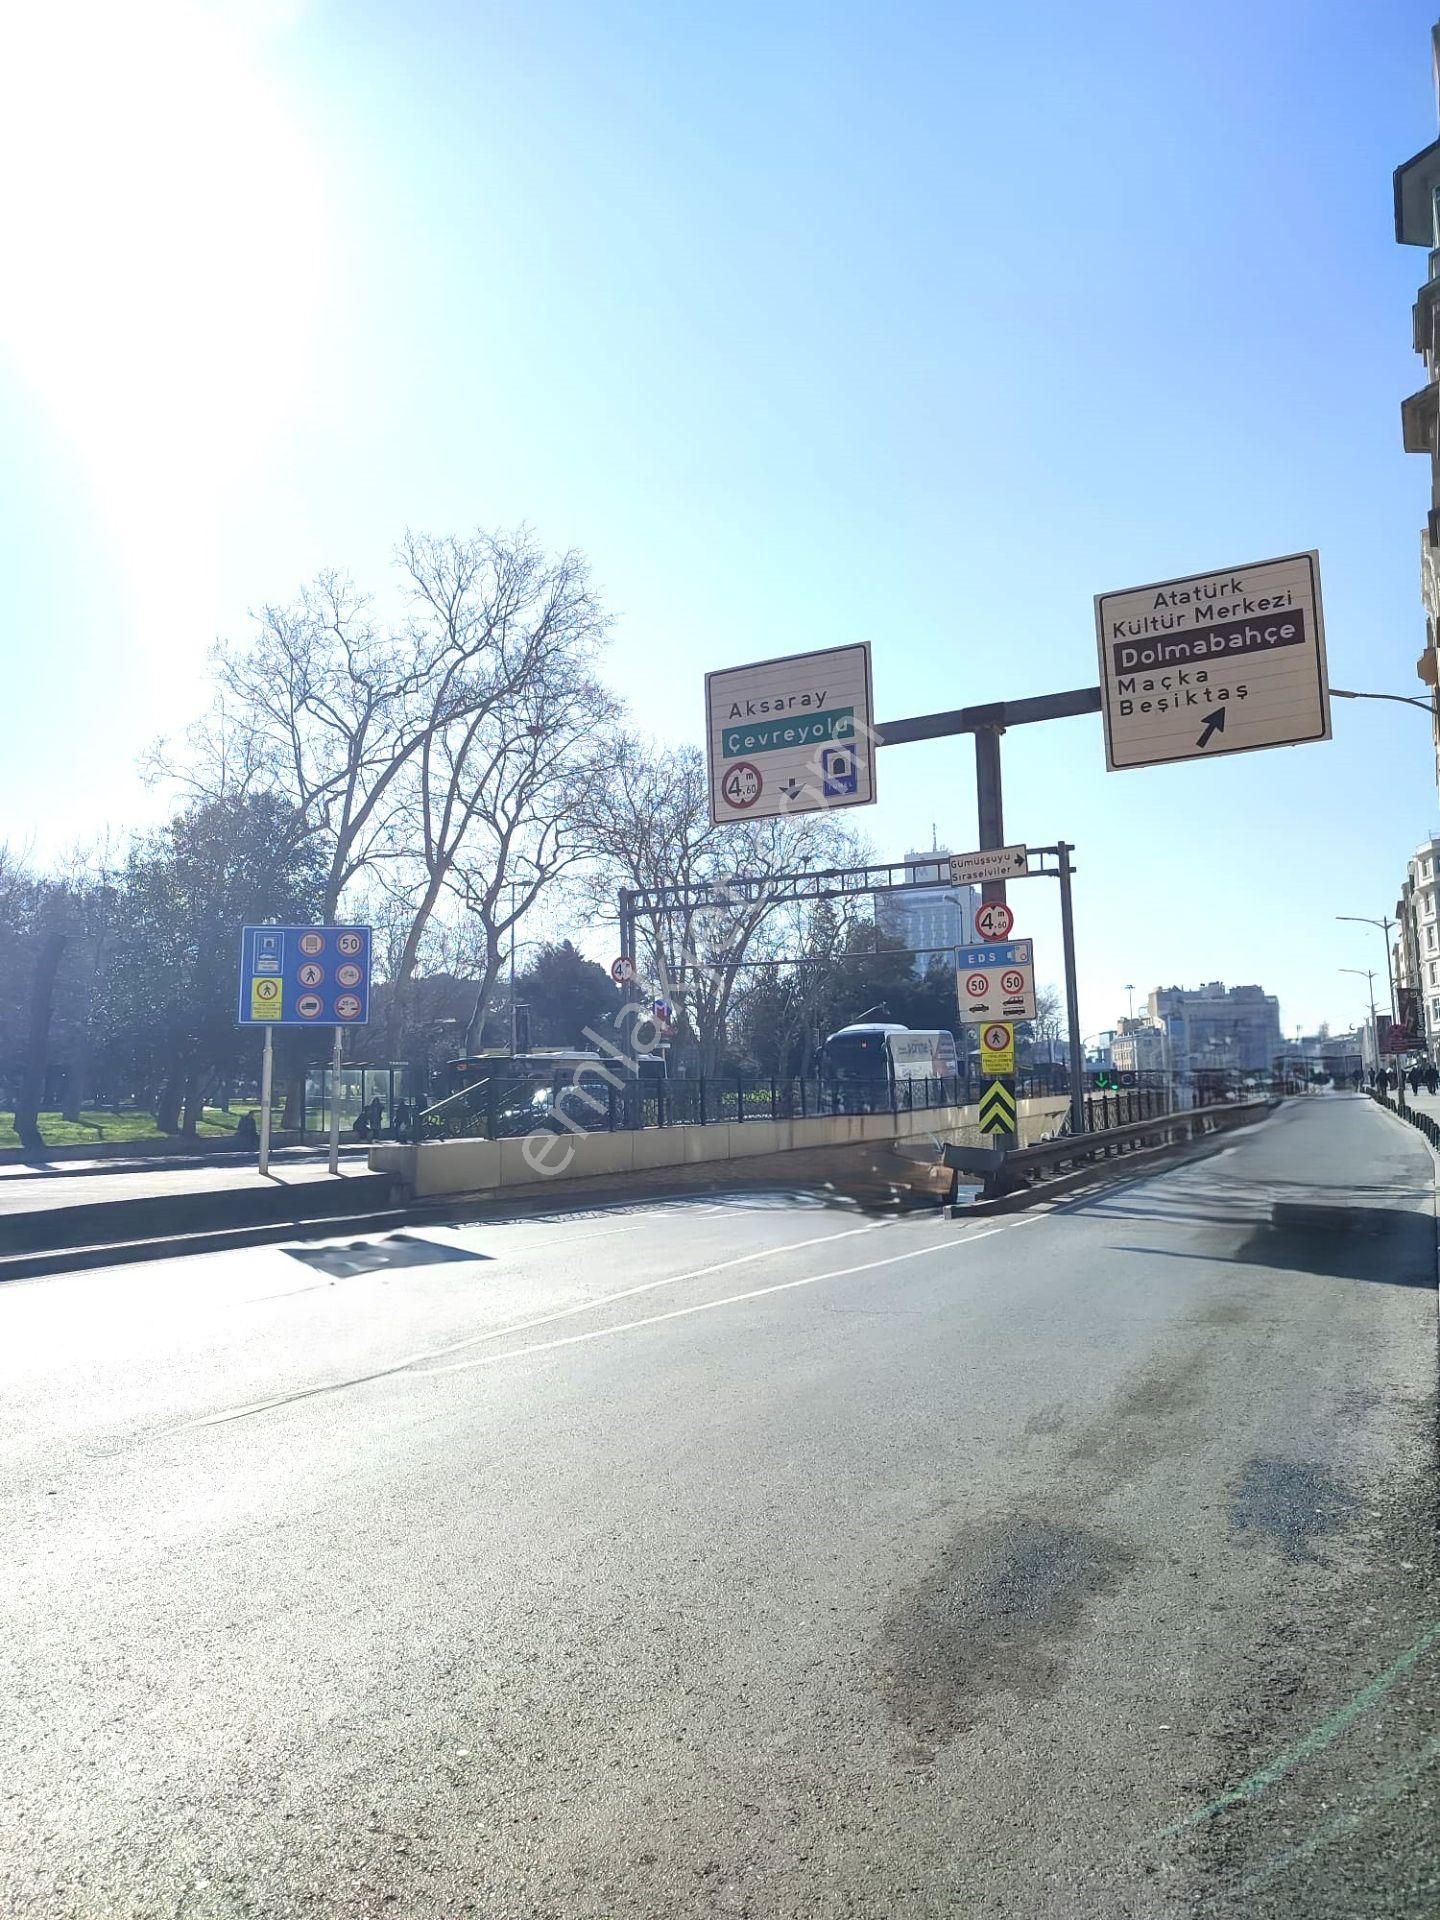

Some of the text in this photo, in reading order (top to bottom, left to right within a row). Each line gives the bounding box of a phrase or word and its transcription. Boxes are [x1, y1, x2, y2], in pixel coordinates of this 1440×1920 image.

[1154, 578, 1244, 609] Atatürk
[1113, 589, 1293, 639] Kültür Merkezi
[1121, 624, 1296, 668] Dolmabahçe
[1117, 669, 1209, 696] Maçka
[729, 690, 827, 719] Aksaray
[1120, 683, 1249, 716] Beşiktaş
[728, 718, 849, 753] Çevreyolu
[342, 938, 358, 950] 50
[971, 976, 1020, 991] 50 50
